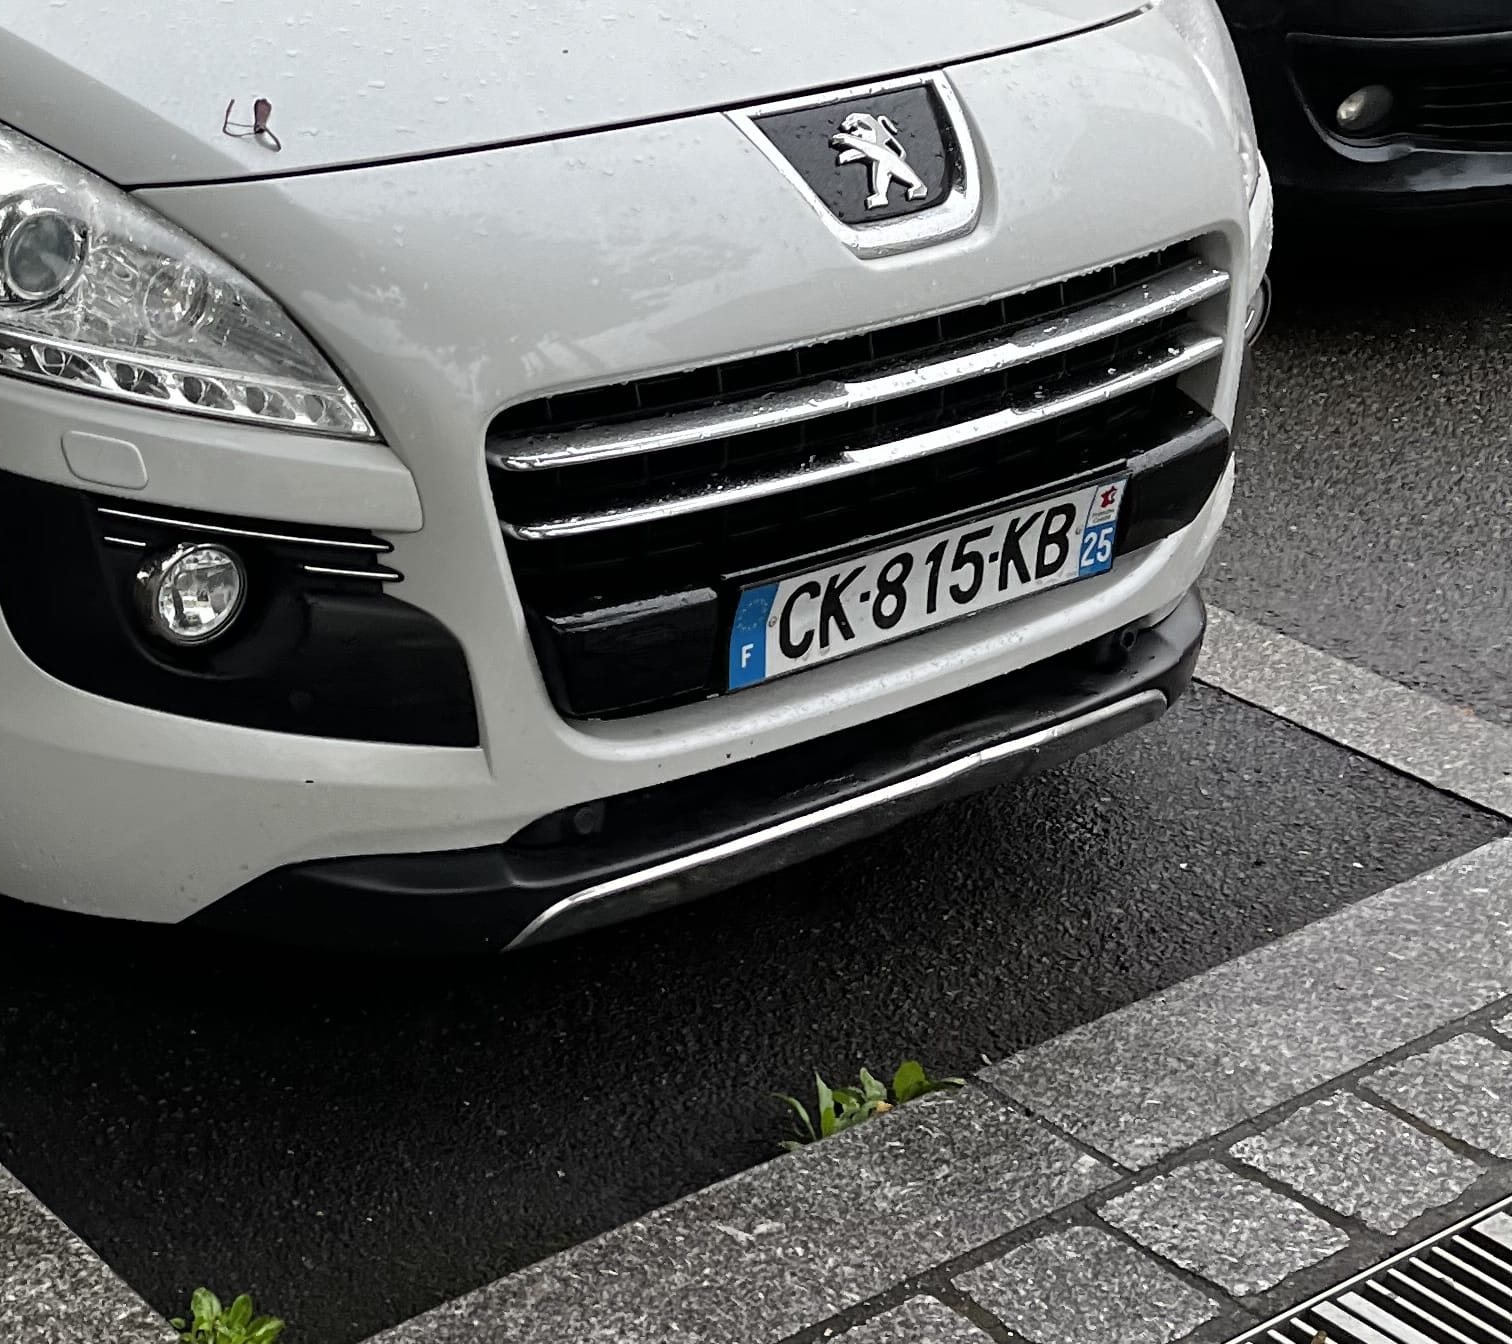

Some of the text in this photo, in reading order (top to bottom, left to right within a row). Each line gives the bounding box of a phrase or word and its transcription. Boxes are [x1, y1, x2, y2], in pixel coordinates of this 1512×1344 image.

[740, 502, 1114, 669] F CK-815-KB 25
